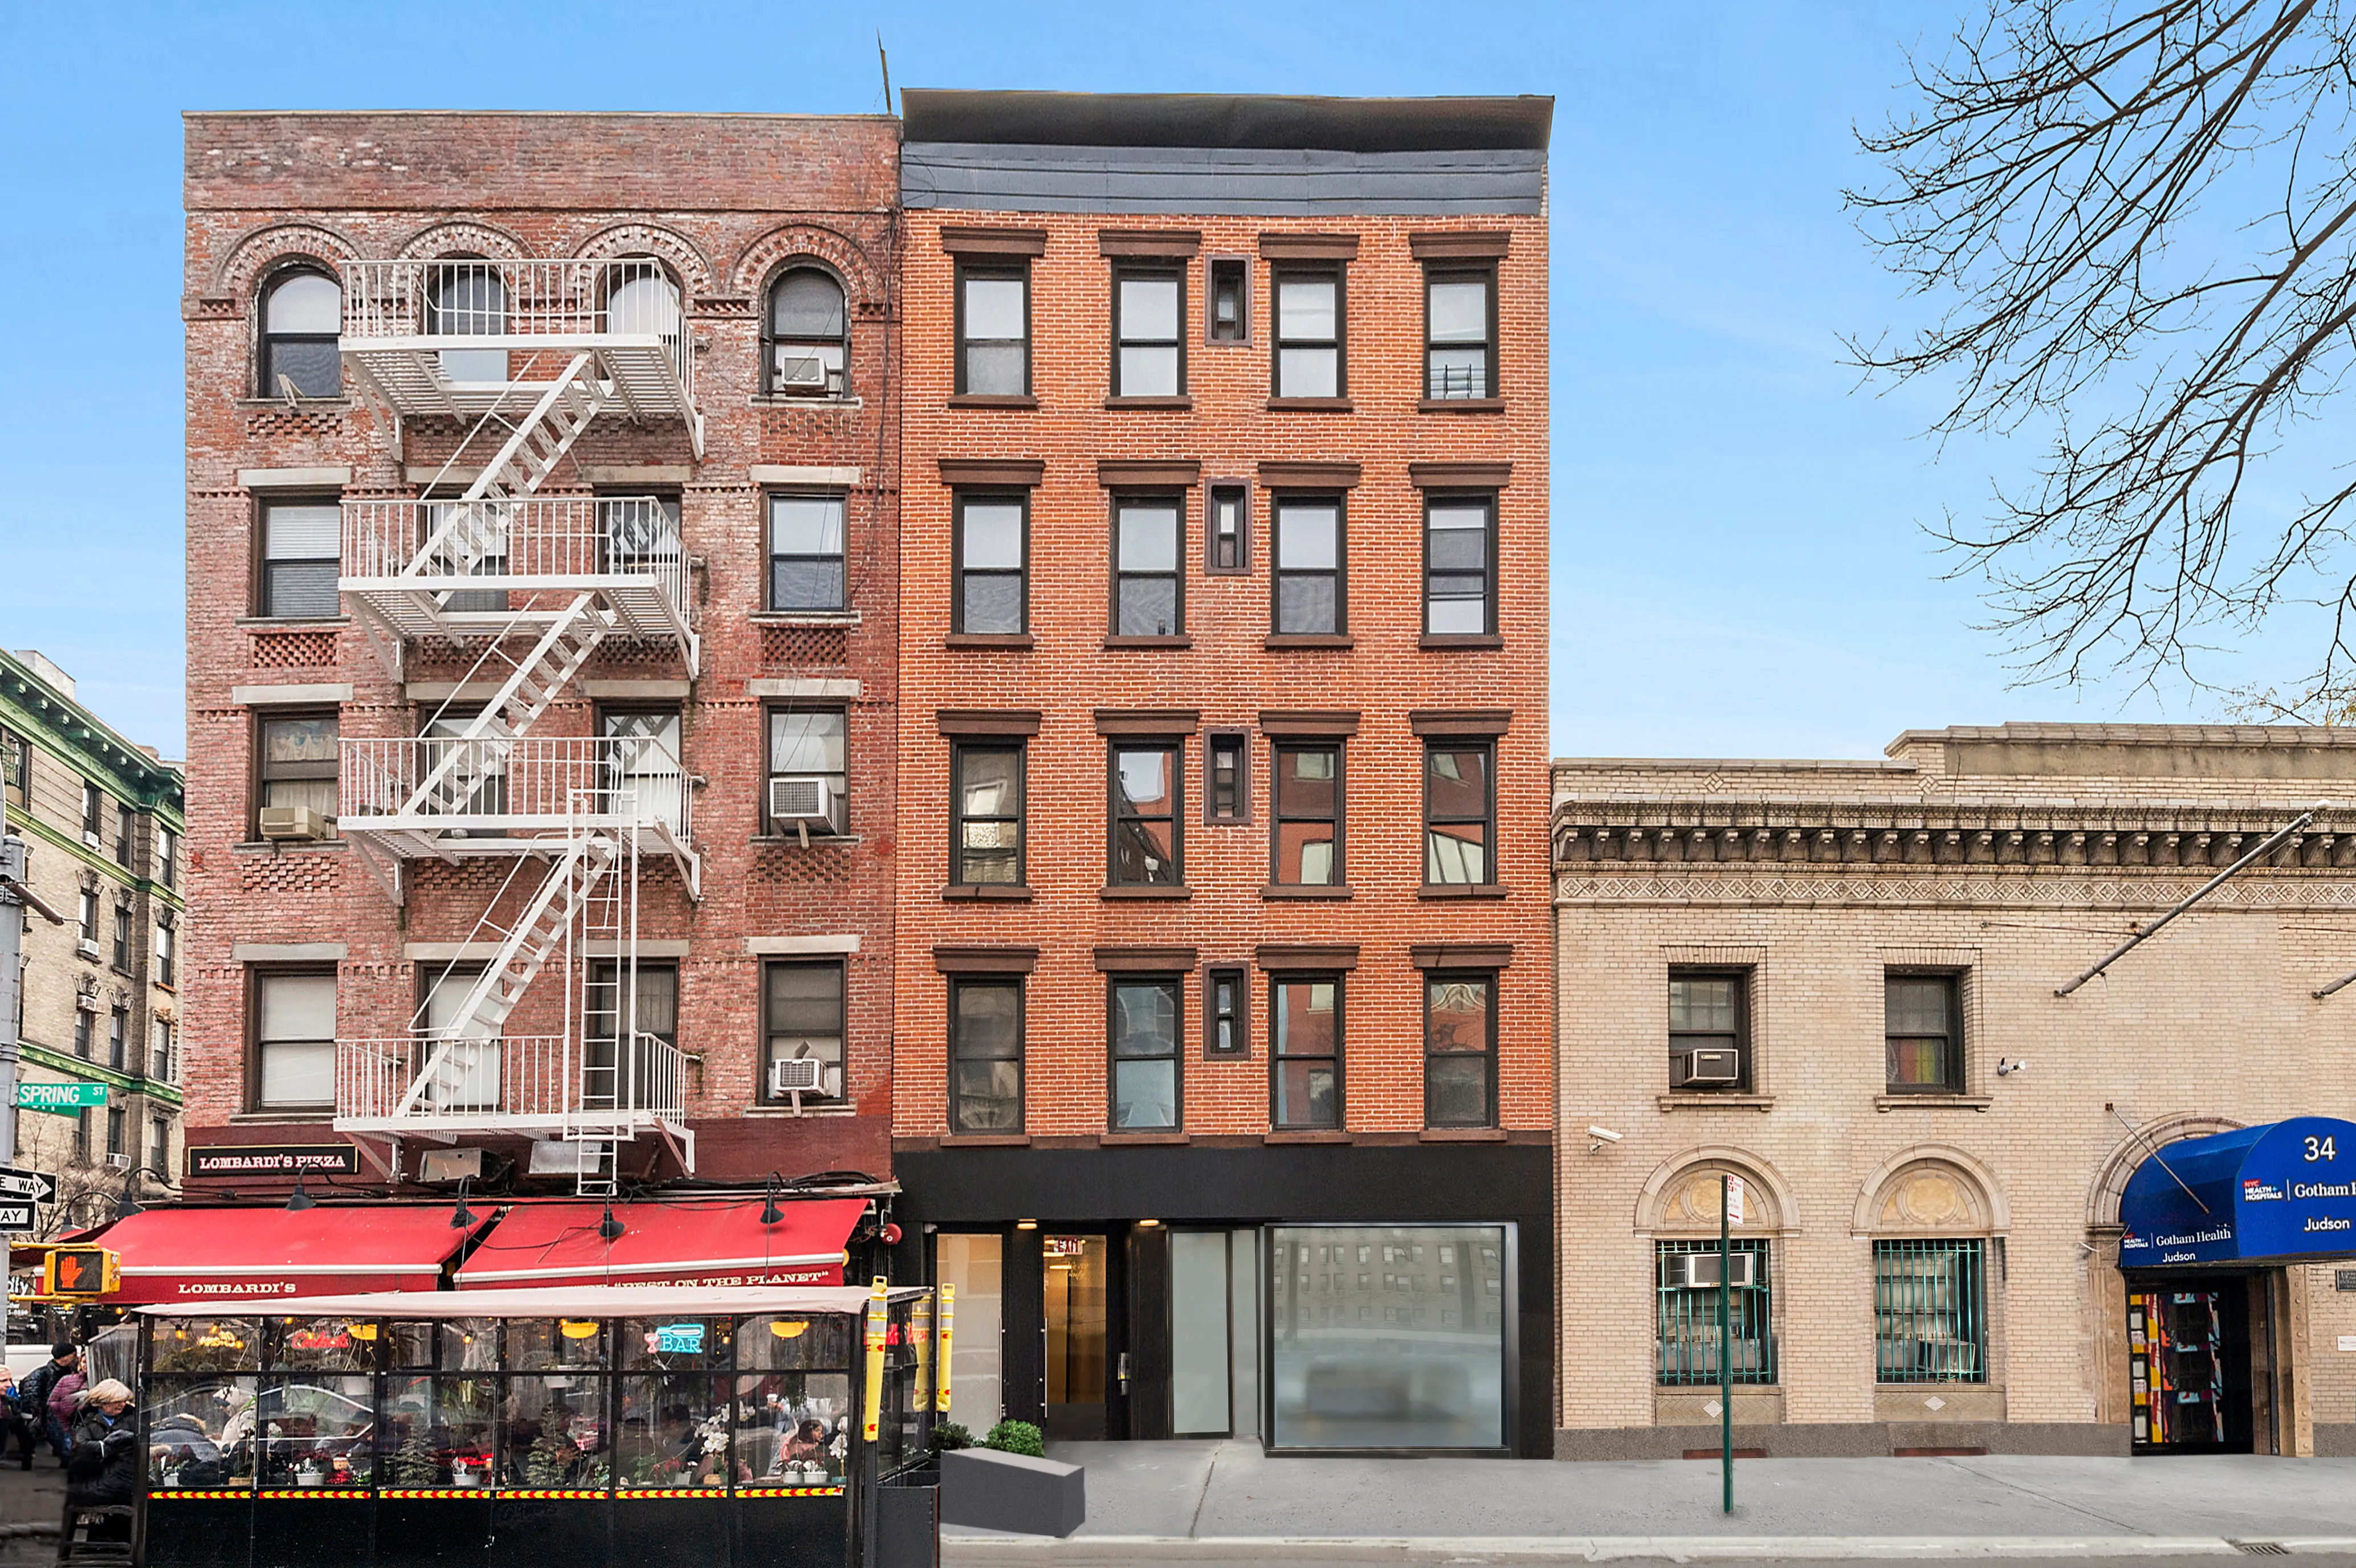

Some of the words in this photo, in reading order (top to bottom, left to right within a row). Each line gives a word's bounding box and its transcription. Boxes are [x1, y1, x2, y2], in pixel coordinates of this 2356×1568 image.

[20, 1085, 80, 1104] SPRING
[92, 1086, 104, 1096] ST
[2304, 1136, 2335, 1161] 34
[199, 1153, 292, 1169] LOMBARDI'S
[295, 1155, 345, 1168] PIZZA
[18, 1179, 43, 1194] WAY
[2294, 1182, 2349, 1198] Gotham
[2245, 1191, 2282, 1202] HOSPITALS
[0, 1210, 21, 1222] AY
[2304, 1216, 2350, 1231] Judson
[2156, 1234, 2195, 1247] Gotham
[2196, 1228, 2231, 1243] Health
[2162, 1251, 2196, 1263] Judson
[178, 1281, 296, 1294] LOMBARDI'S
[703, 1276, 741, 1287] THE
[660, 1336, 703, 1353] BAR
